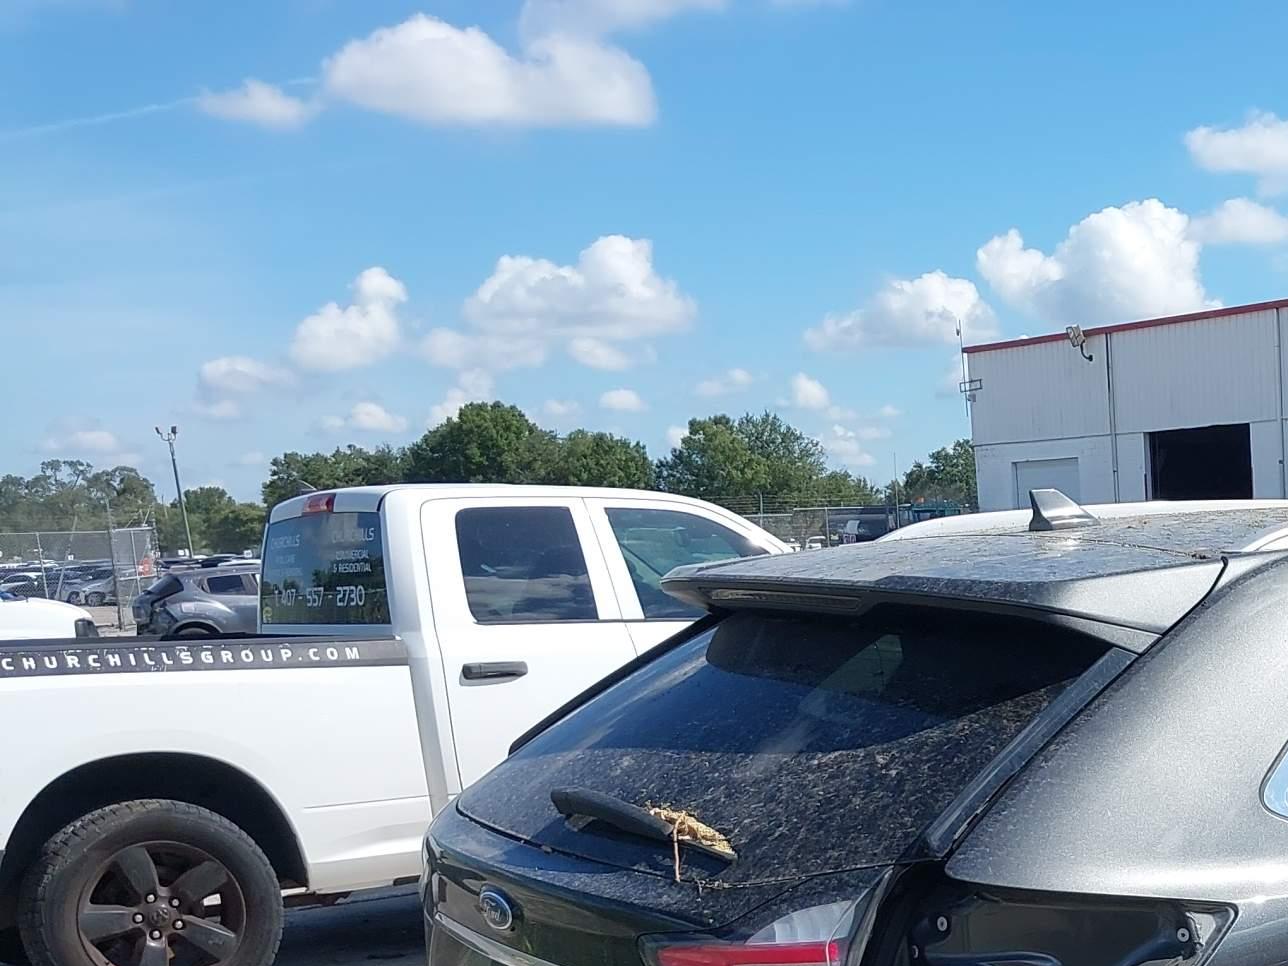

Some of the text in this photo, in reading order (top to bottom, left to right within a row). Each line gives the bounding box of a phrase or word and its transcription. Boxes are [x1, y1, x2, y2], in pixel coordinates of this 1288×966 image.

[332, 527, 374, 543] CILLS
[281, 589, 296, 607] 407
[306, 586, 324, 607] 557
[336, 585, 365, 607] 2730
